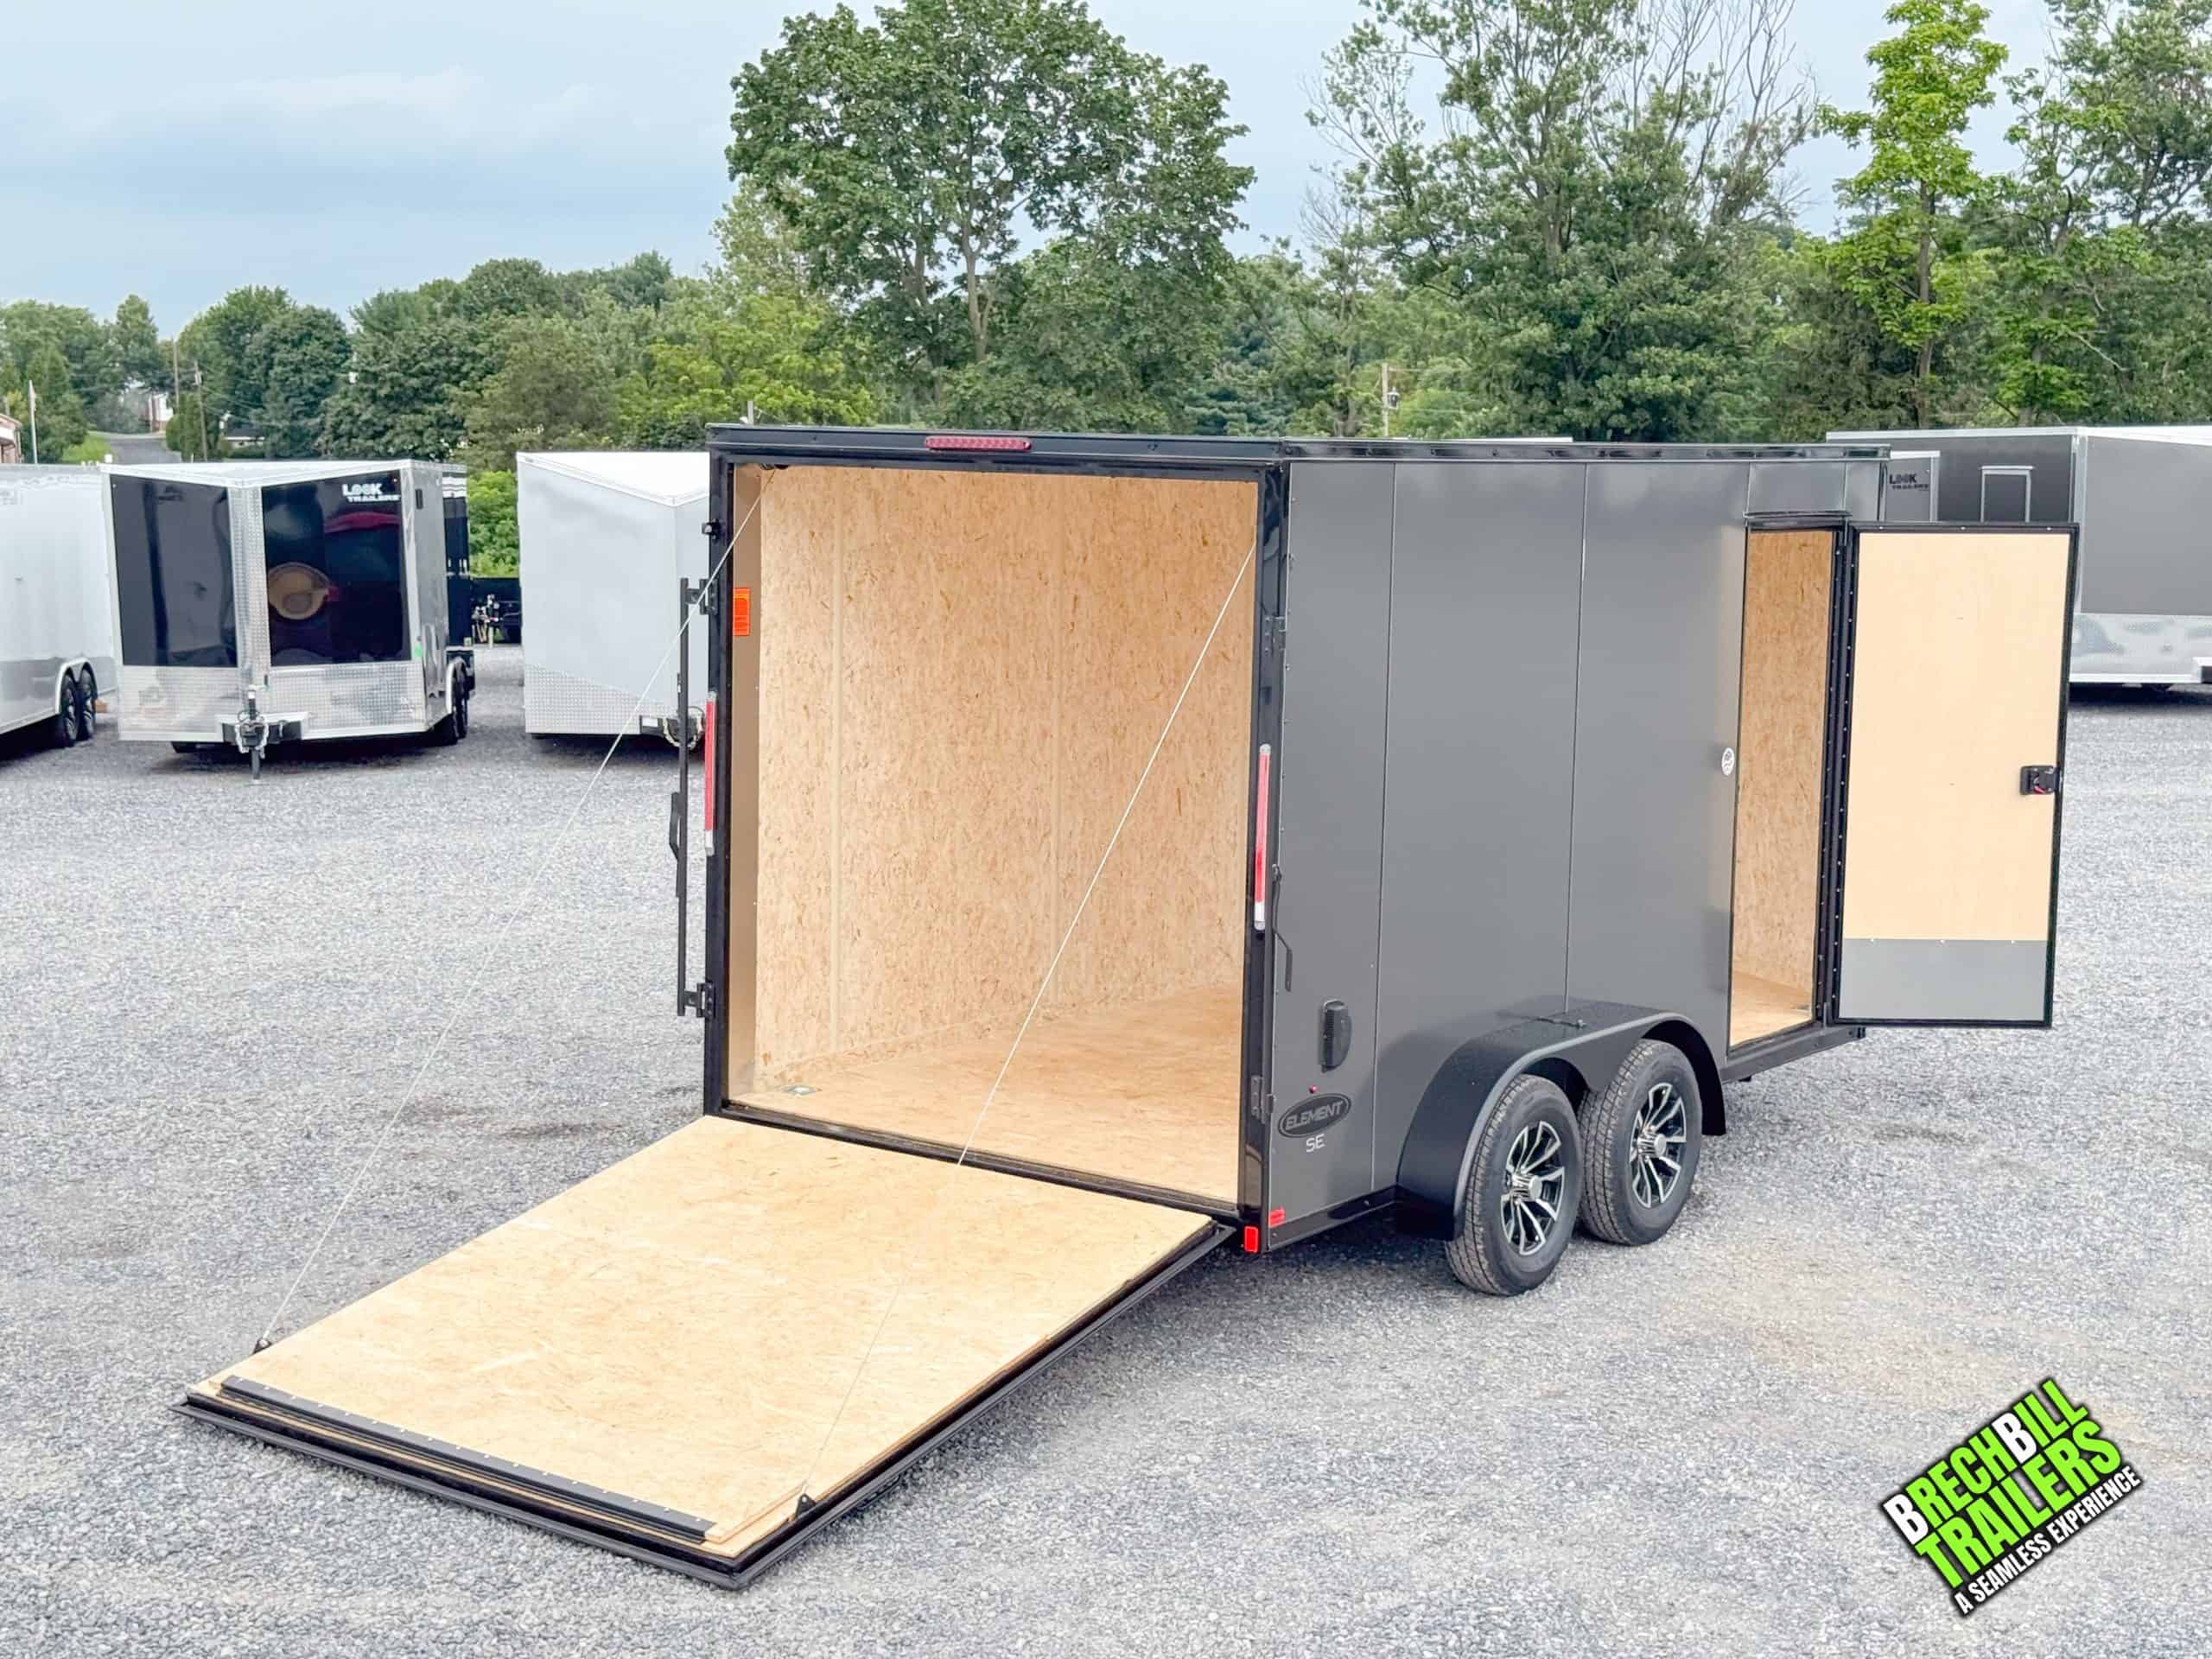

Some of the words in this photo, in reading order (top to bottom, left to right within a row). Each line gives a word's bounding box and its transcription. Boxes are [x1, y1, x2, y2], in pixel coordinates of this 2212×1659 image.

[342, 483, 383, 496] LOOK
[1285, 1101, 1343, 1130] ELEMENT
[1306, 1134, 1325, 1153] SE
